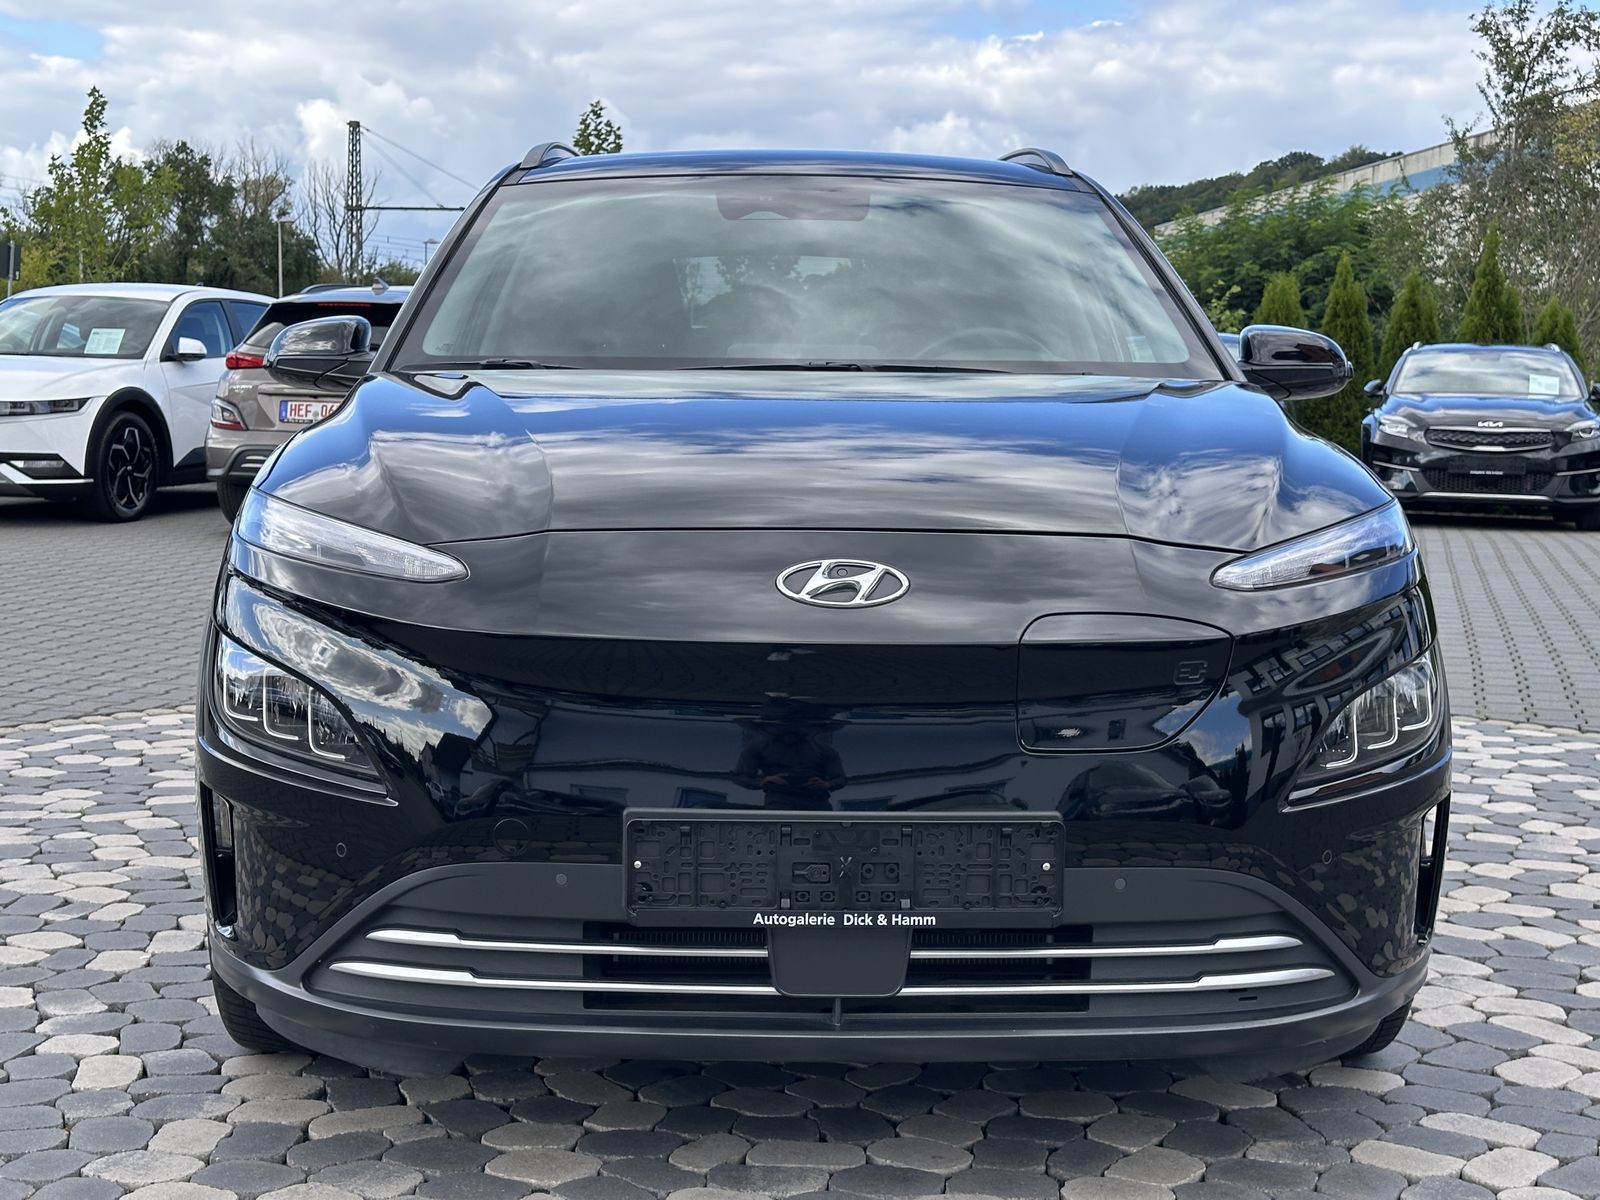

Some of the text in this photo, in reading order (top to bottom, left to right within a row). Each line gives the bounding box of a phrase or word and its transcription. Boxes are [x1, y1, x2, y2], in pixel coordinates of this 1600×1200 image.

[289, 403, 313, 418] HEF
[752, 912, 937, 928] Autogalerie Dick & Hamm
